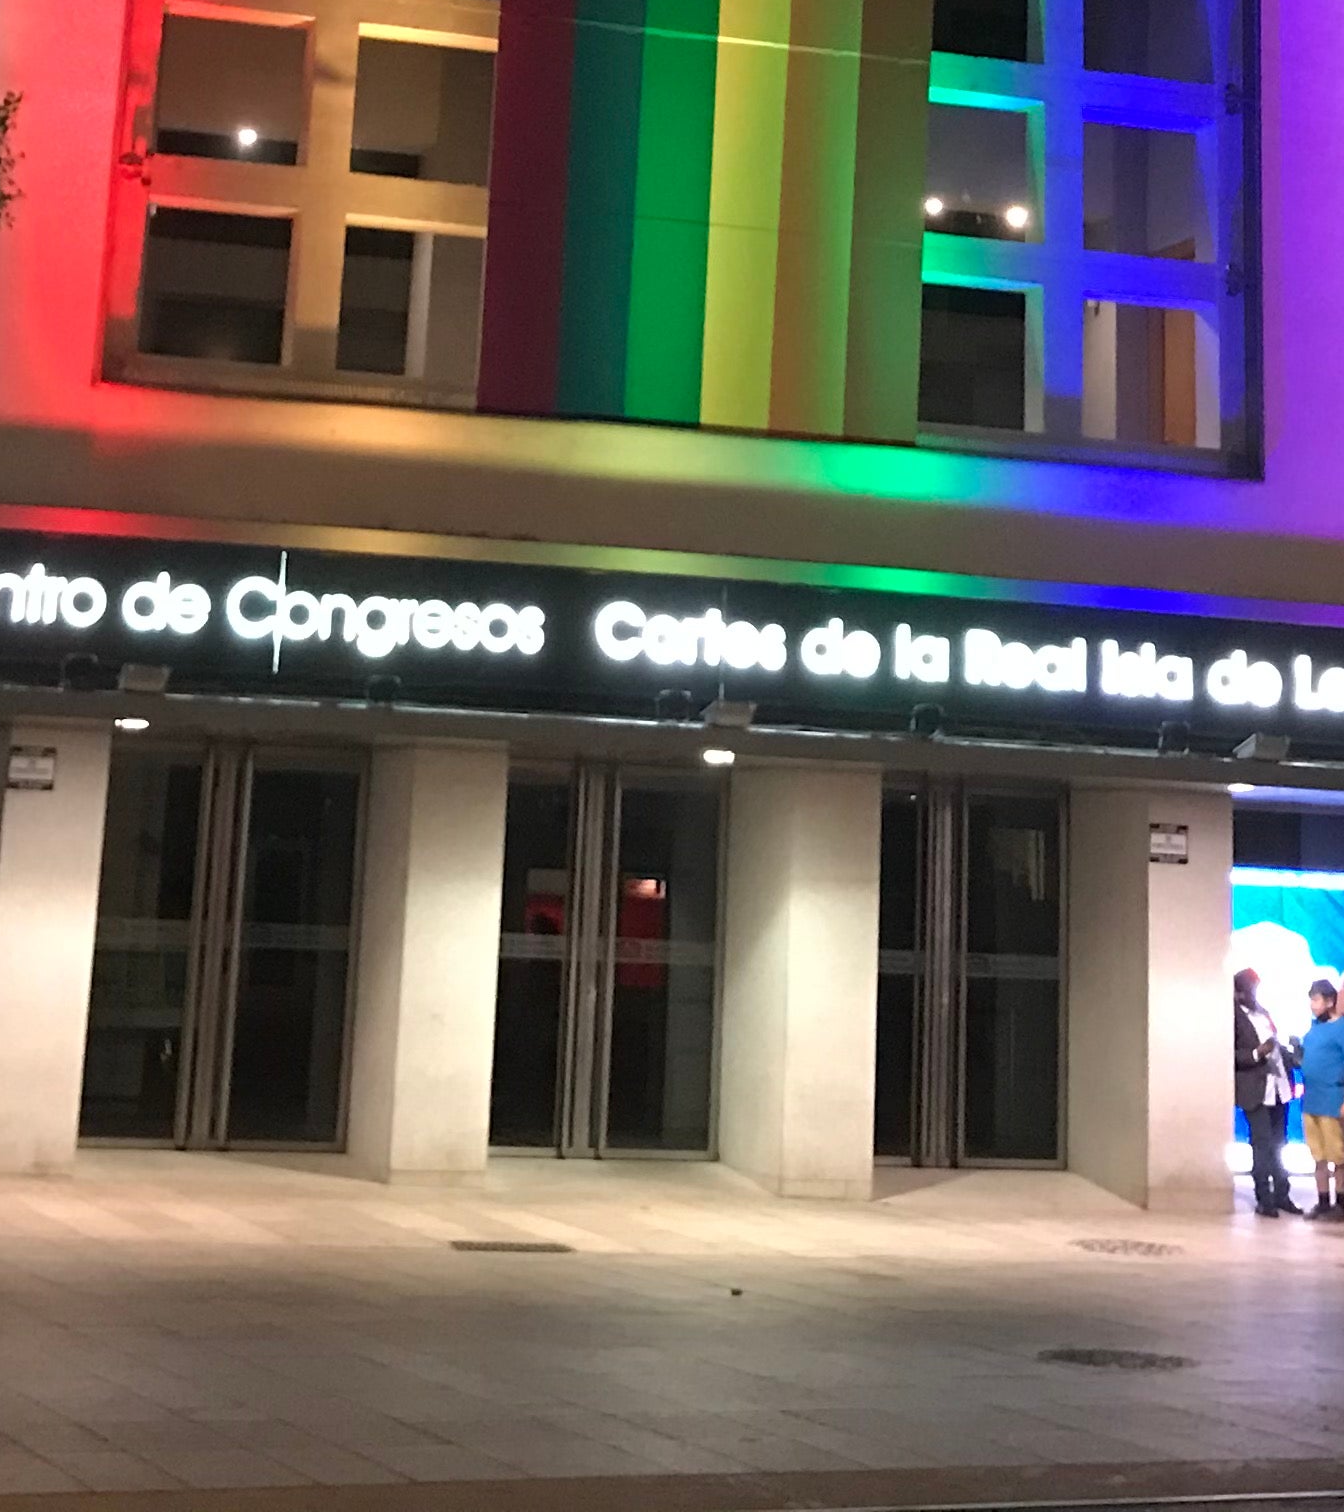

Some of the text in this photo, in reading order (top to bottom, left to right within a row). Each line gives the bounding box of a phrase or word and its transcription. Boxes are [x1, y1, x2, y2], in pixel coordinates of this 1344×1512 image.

[121, 571, 211, 634] de
[226, 576, 546, 658] Congresos
[800, 617, 882, 679] de
[894, 623, 950, 683] la
[964, 628, 1087, 693] Real
[1101, 639, 1194, 701] Isla
[1206, 649, 1283, 708] de
